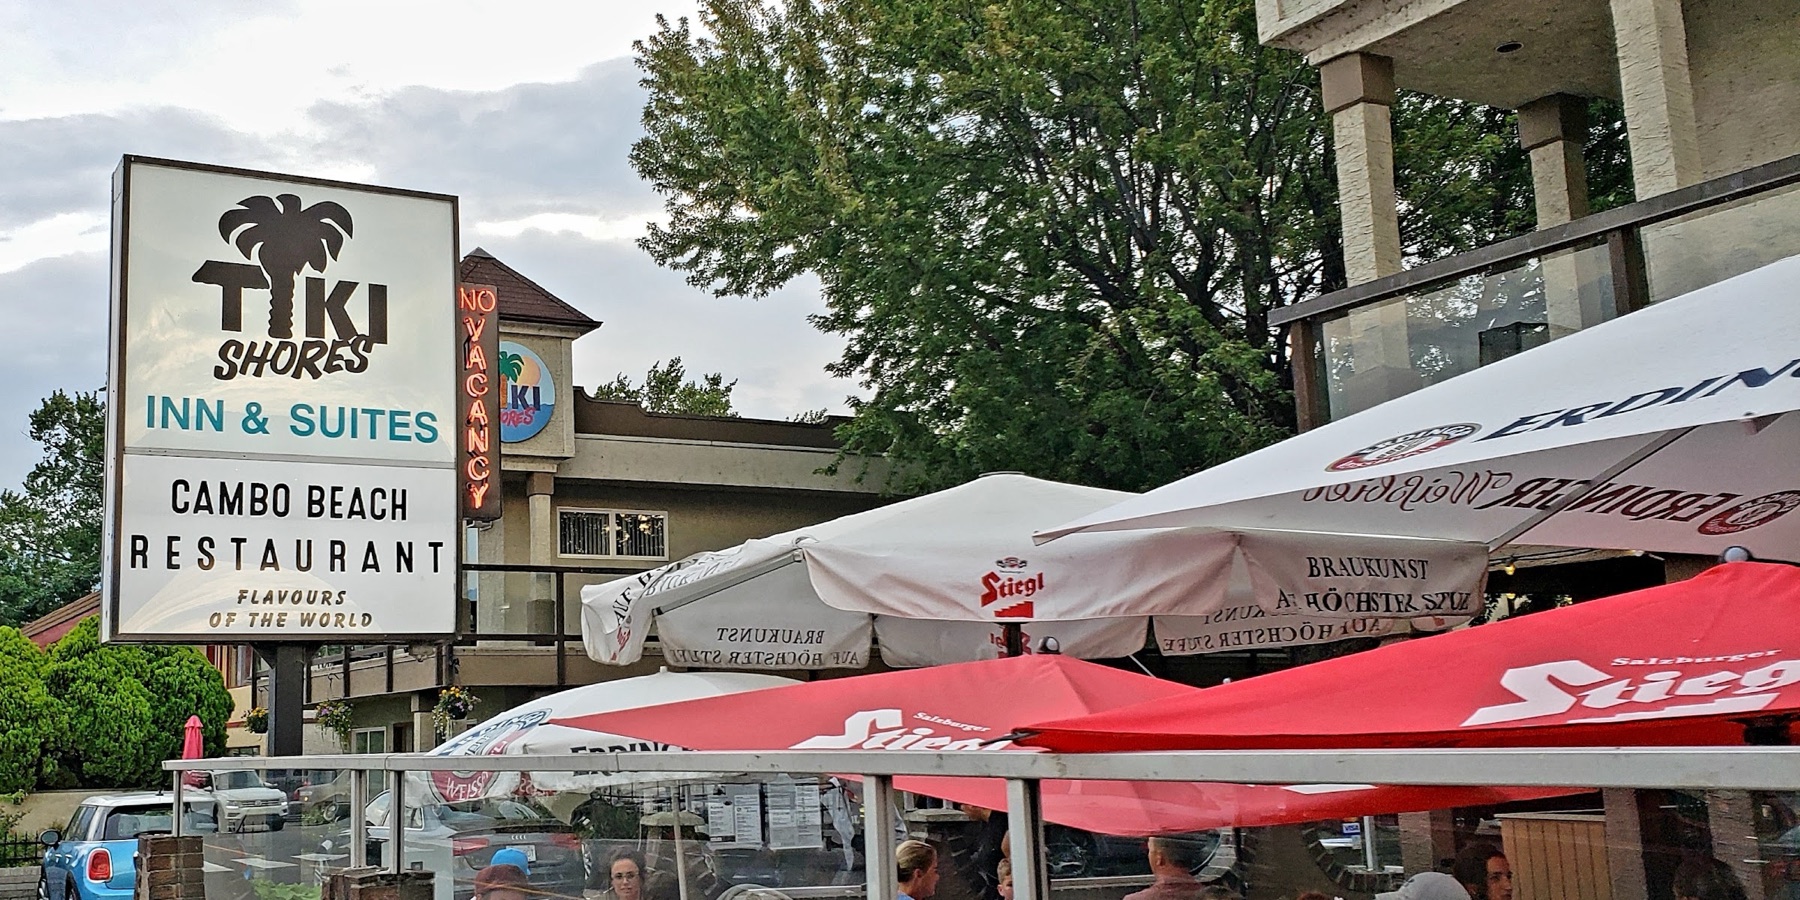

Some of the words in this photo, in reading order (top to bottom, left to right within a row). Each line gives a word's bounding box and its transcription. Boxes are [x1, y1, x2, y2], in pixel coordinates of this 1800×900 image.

[191, 258, 388, 345] TIKI
[460, 287, 496, 312] NO
[213, 334, 373, 381] SHORES
[463, 316, 490, 509] VACANCY
[500, 405, 536, 428] ORES
[1472, 358, 1800, 442] ERDIN
[146, 395, 224, 432] INN
[242, 401, 271, 435] &
[290, 402, 439, 444] SUITES
[171, 478, 291, 518] CAMBO
[307, 484, 408, 521] BEACH
[130, 534, 444, 574] RESTAURANT
[1306, 556, 1429, 580] BRAUKUNST
[236, 588, 347, 606] FLAVOURS
[980, 571, 1045, 608] Stiegl
[208, 612, 242, 629] OF
[247, 612, 288, 629] THE
[299, 611, 373, 629] WORLD
[1610, 649, 1783, 667] Salzburger
[913, 711, 992, 733] Salzburger
